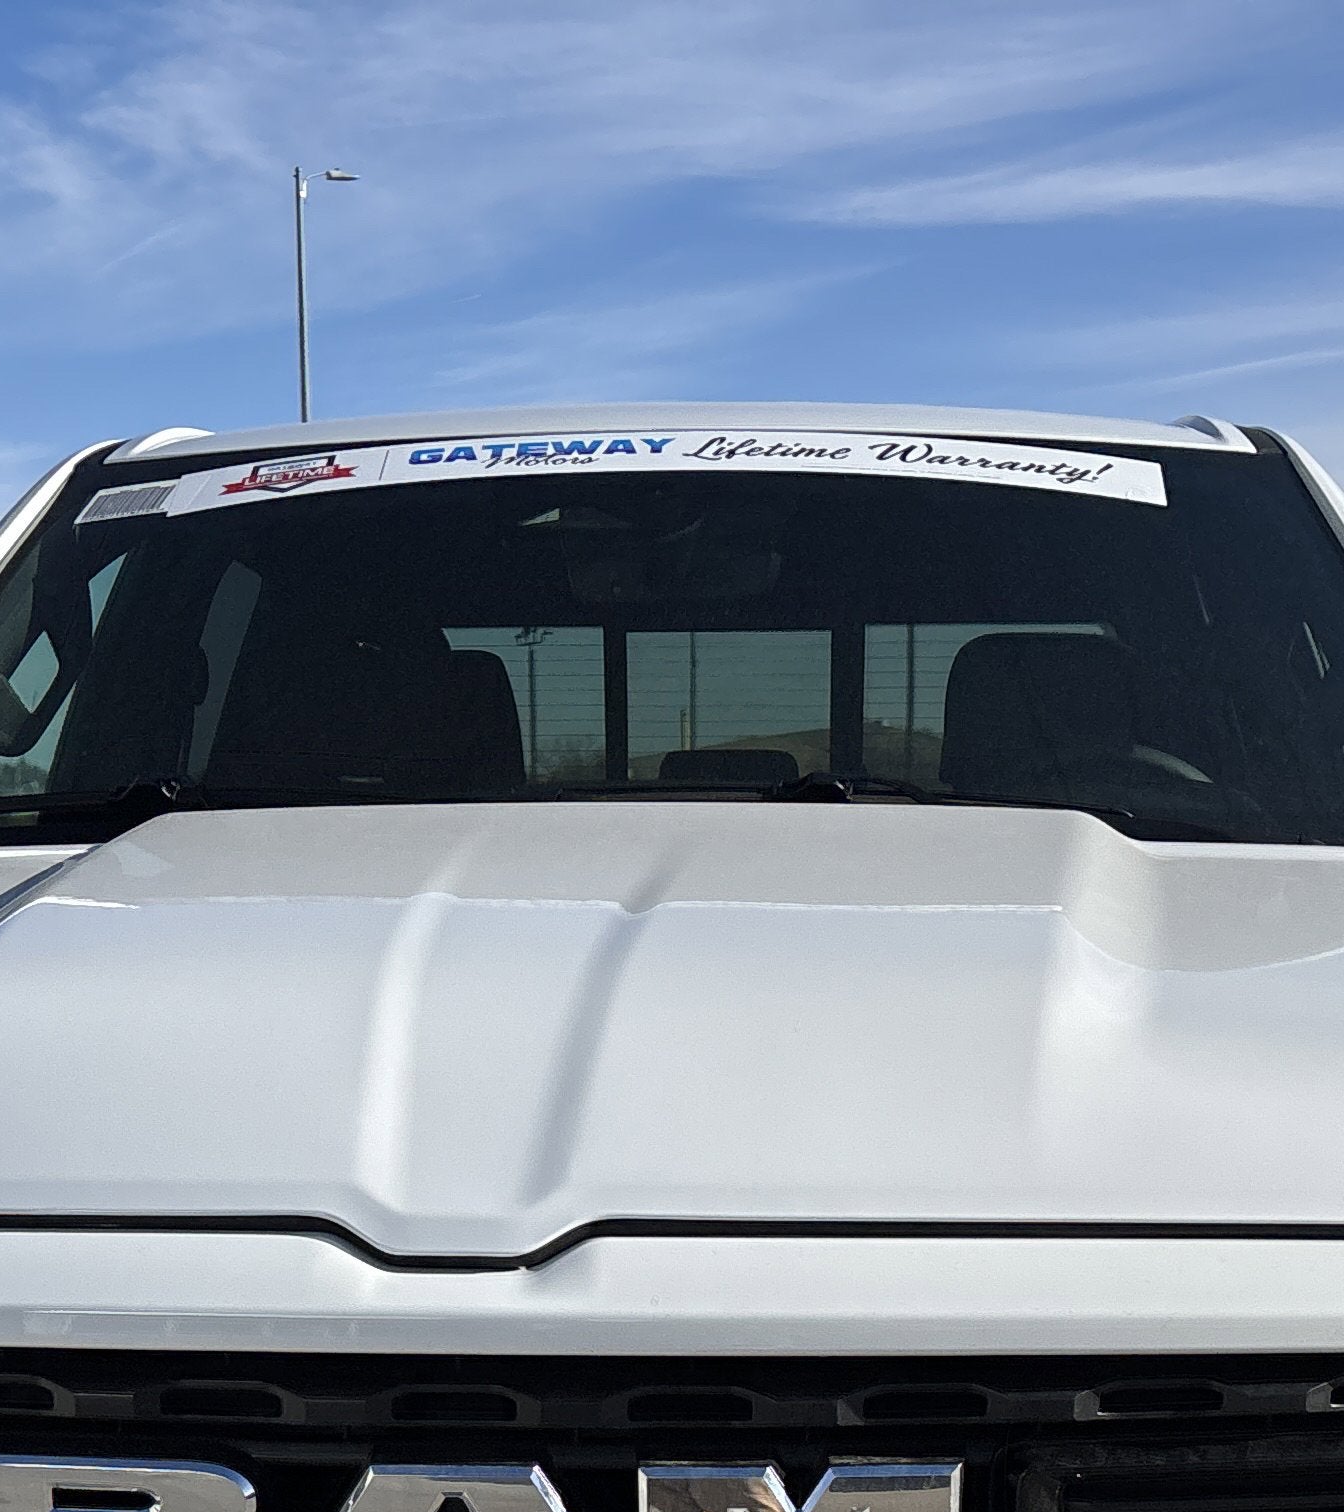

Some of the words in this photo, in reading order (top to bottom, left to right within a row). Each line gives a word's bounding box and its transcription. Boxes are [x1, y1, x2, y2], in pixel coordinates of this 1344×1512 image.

[408, 438, 677, 466] GATEWAY
[682, 436, 852, 461] Lifetime
[868, 443, 1113, 483] Warranty!
[480, 453, 601, 469] Motors
[244, 464, 336, 486] LIFETIME
